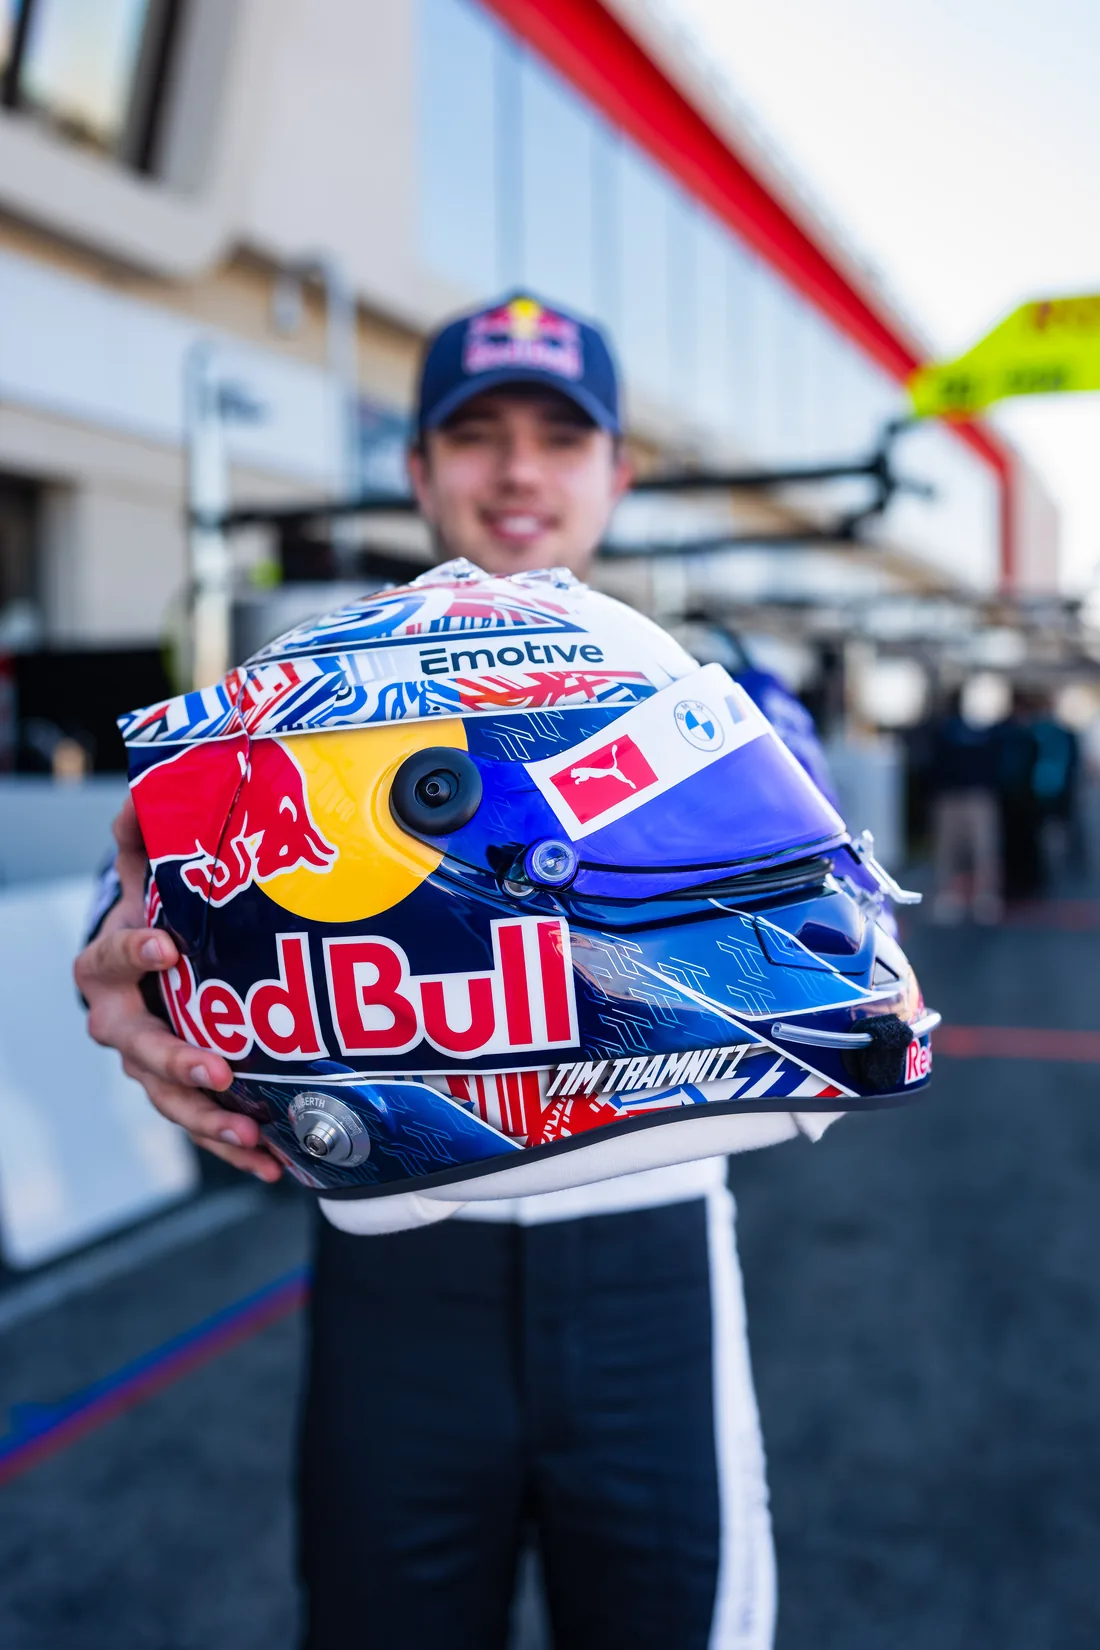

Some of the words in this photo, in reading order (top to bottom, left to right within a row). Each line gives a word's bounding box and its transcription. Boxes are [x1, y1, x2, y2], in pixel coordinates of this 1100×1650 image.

[420, 641, 604, 676] Emotive
[676, 702, 704, 722] BMW
[162, 932, 329, 1061] Red
[322, 916, 580, 1059] Bull
[546, 1061, 605, 1097] TIM
[602, 1044, 751, 1093] TRAMNITZ
